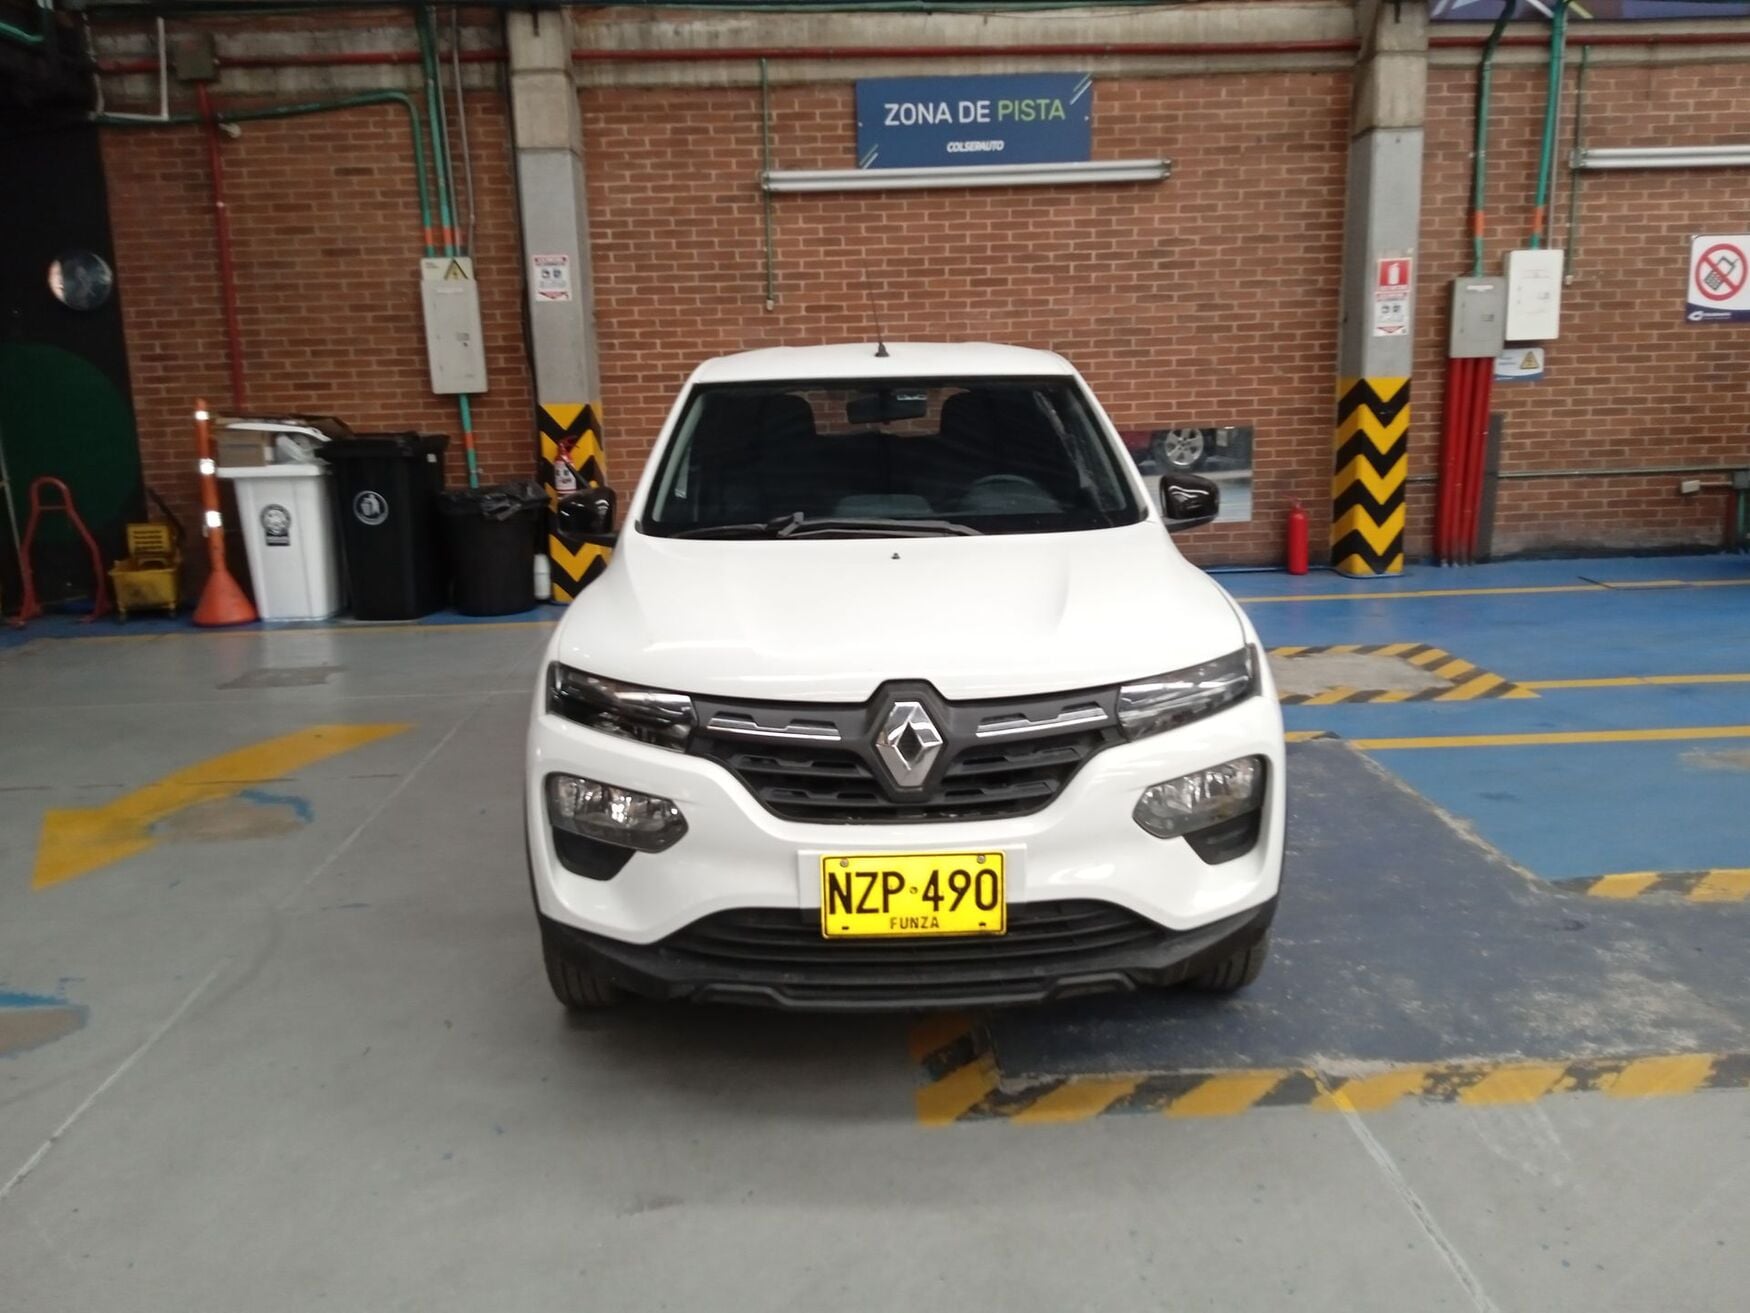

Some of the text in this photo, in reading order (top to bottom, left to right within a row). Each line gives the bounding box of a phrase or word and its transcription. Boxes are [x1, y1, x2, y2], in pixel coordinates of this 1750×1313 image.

[884, 99, 1066, 126] ZONA DE PISTA
[889, 916, 940, 929] FUNZA
